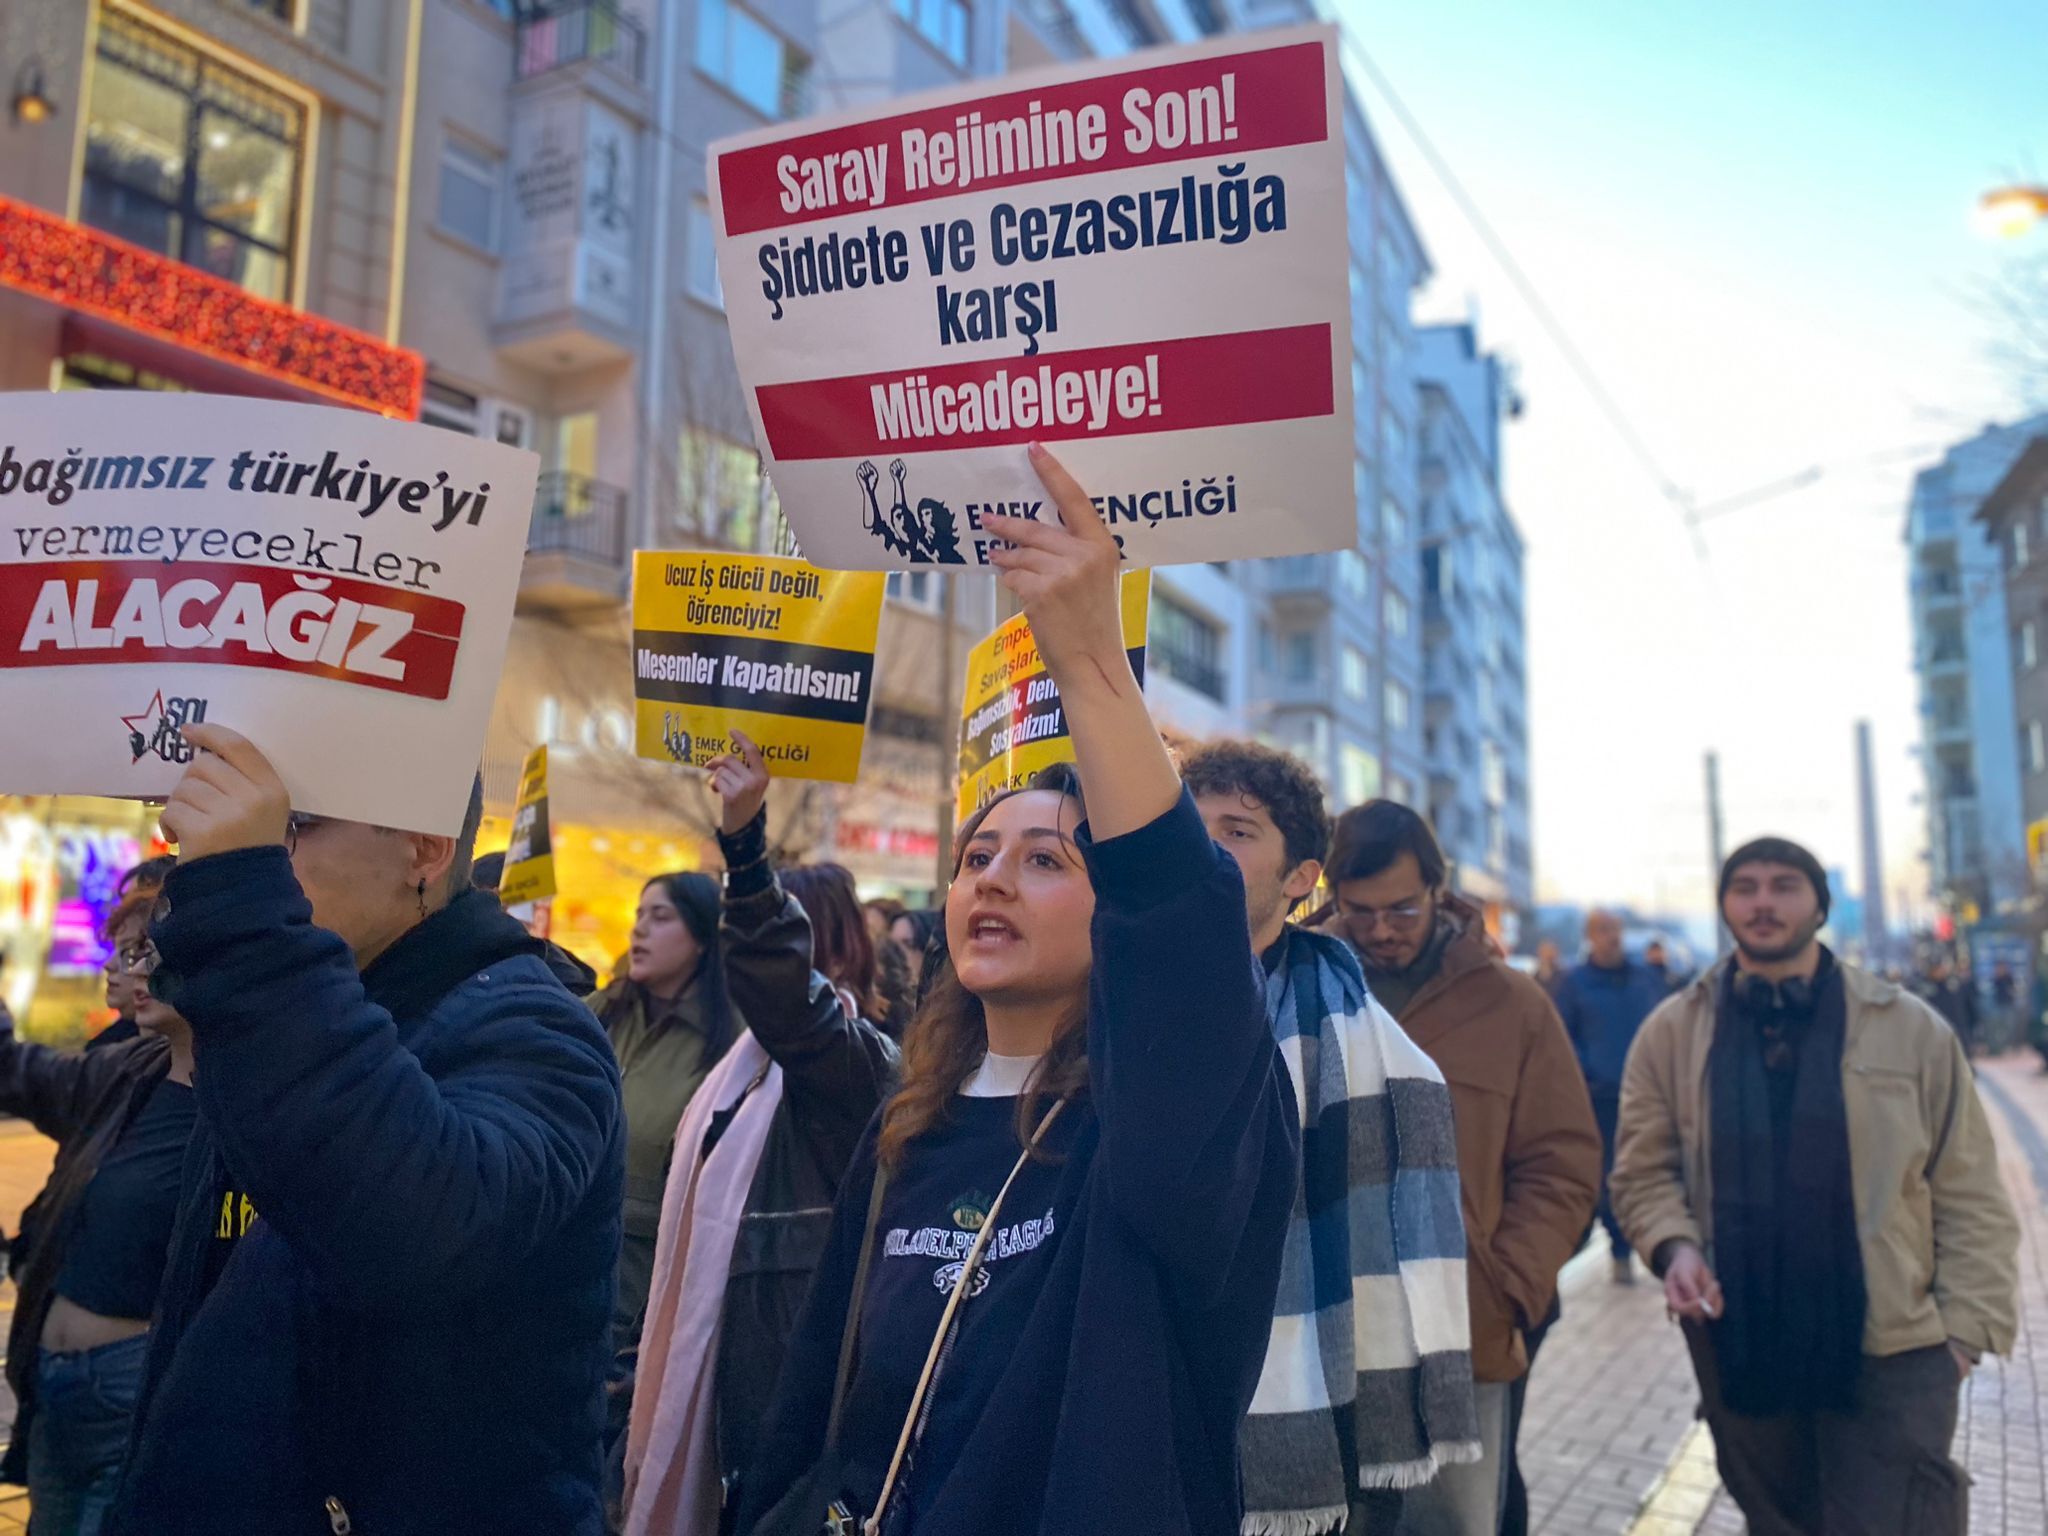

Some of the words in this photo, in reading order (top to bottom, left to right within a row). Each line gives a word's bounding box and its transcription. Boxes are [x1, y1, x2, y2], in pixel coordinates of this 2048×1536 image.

[777, 144, 888, 214] Saray
[901, 100, 1107, 191] Rejimine
[1122, 72, 1238, 154] Son!
[759, 226, 909, 320] Şiddete
[921, 219, 976, 276] ve
[990, 162, 1287, 266] Cezasızlığa
[936, 280, 1058, 356] karşı
[870, 354, 1162, 441] Mücadeleye!
[0, 446, 215, 505] bağımsız
[228, 450, 491, 532] türkiye'yi
[14, 525, 441, 589] vermeyecekler
[665, 563, 696, 586] Ucuz
[699, 560, 714, 595] İş
[719, 565, 765, 592] Gücü
[769, 571, 823, 601] Değil,
[19, 573, 415, 681] ALACAĞIZ
[686, 595, 782, 630] Öğrenciyiz!
[637, 649, 718, 685] Mesemler
[721, 655, 861, 703] Kapatılsın!
[695, 736, 725, 753] EMEK
[730, 741, 810, 763] GÇLİĞİ
